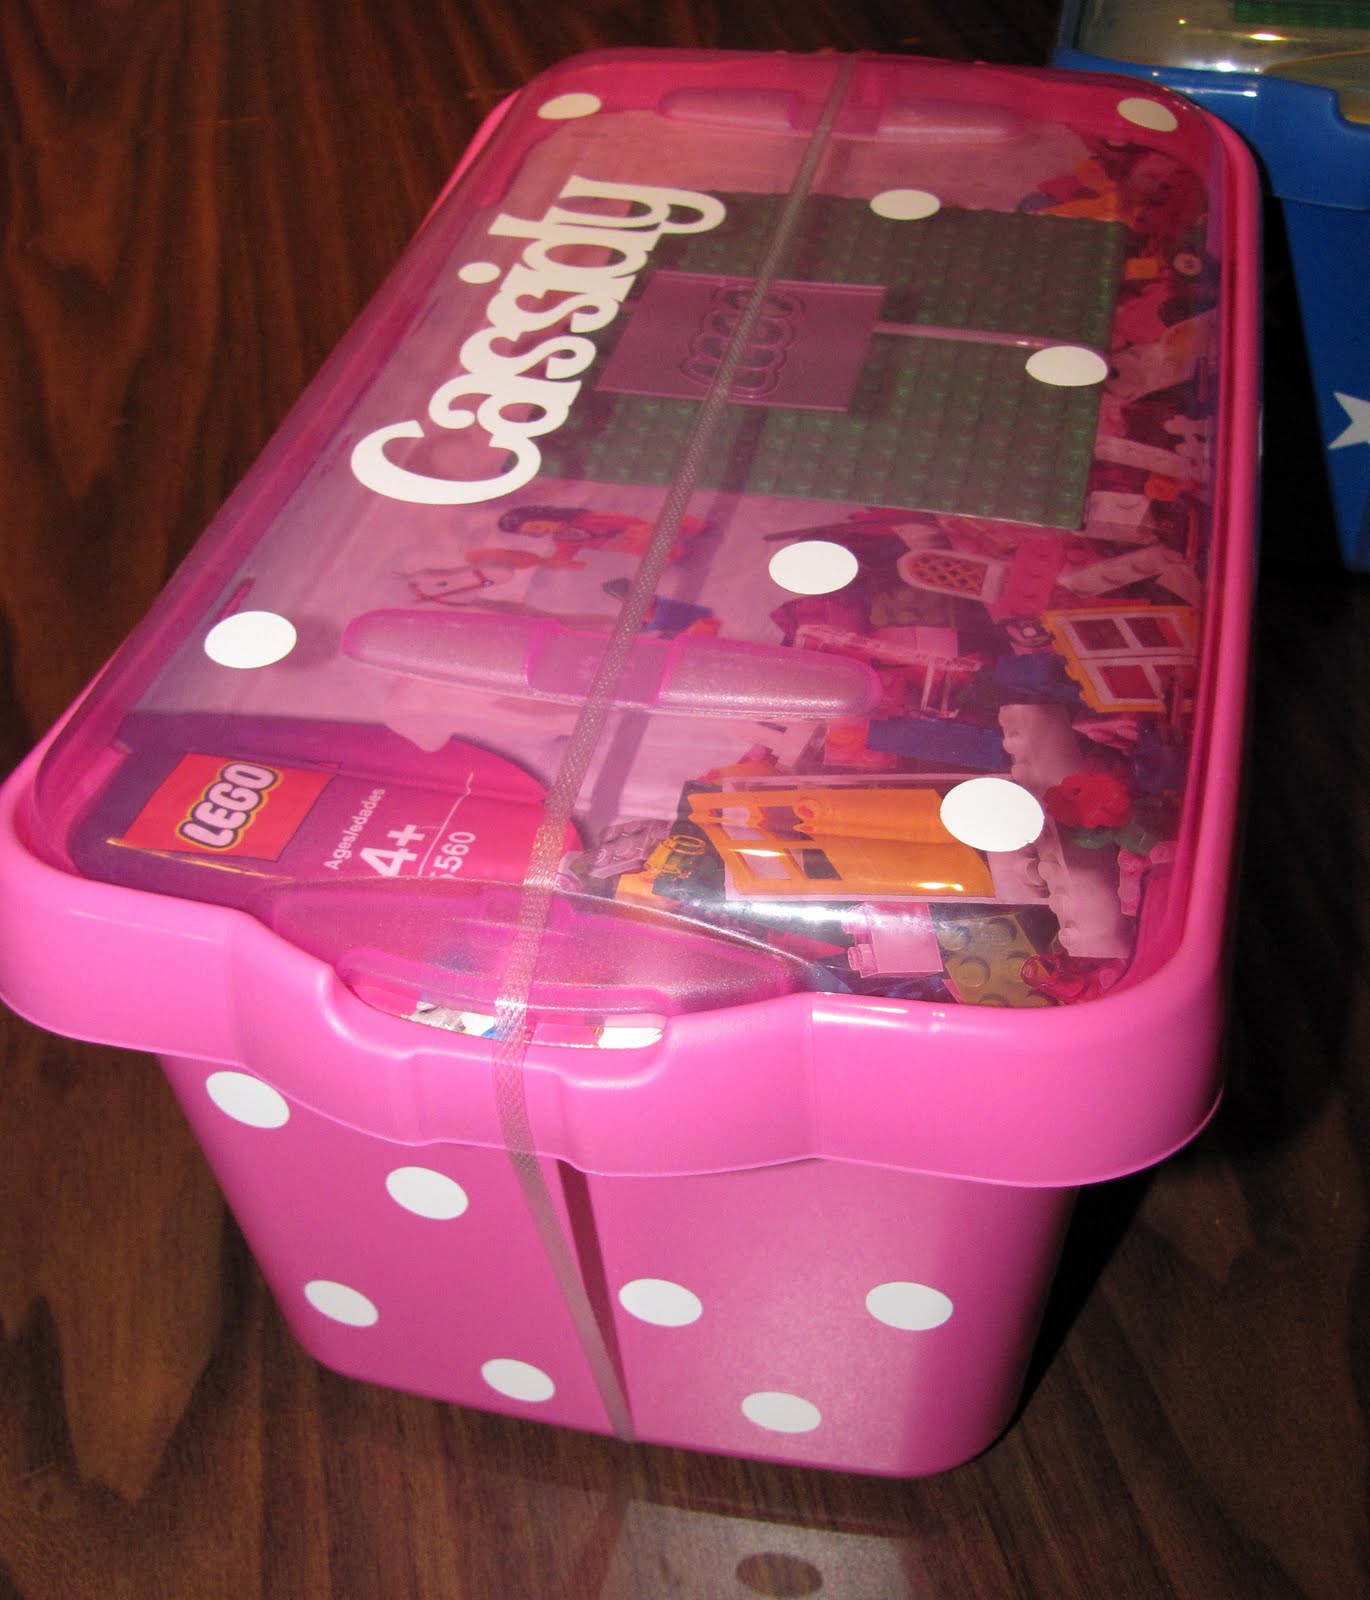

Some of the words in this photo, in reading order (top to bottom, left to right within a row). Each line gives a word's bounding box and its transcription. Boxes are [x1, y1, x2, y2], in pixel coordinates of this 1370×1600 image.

[351, 175, 726, 505] Cassidy
[179, 761, 279, 848] LEGO
[323, 788, 386, 870] Ages/edades
[360, 824, 425, 877] 4+
[430, 831, 476, 878] 560
